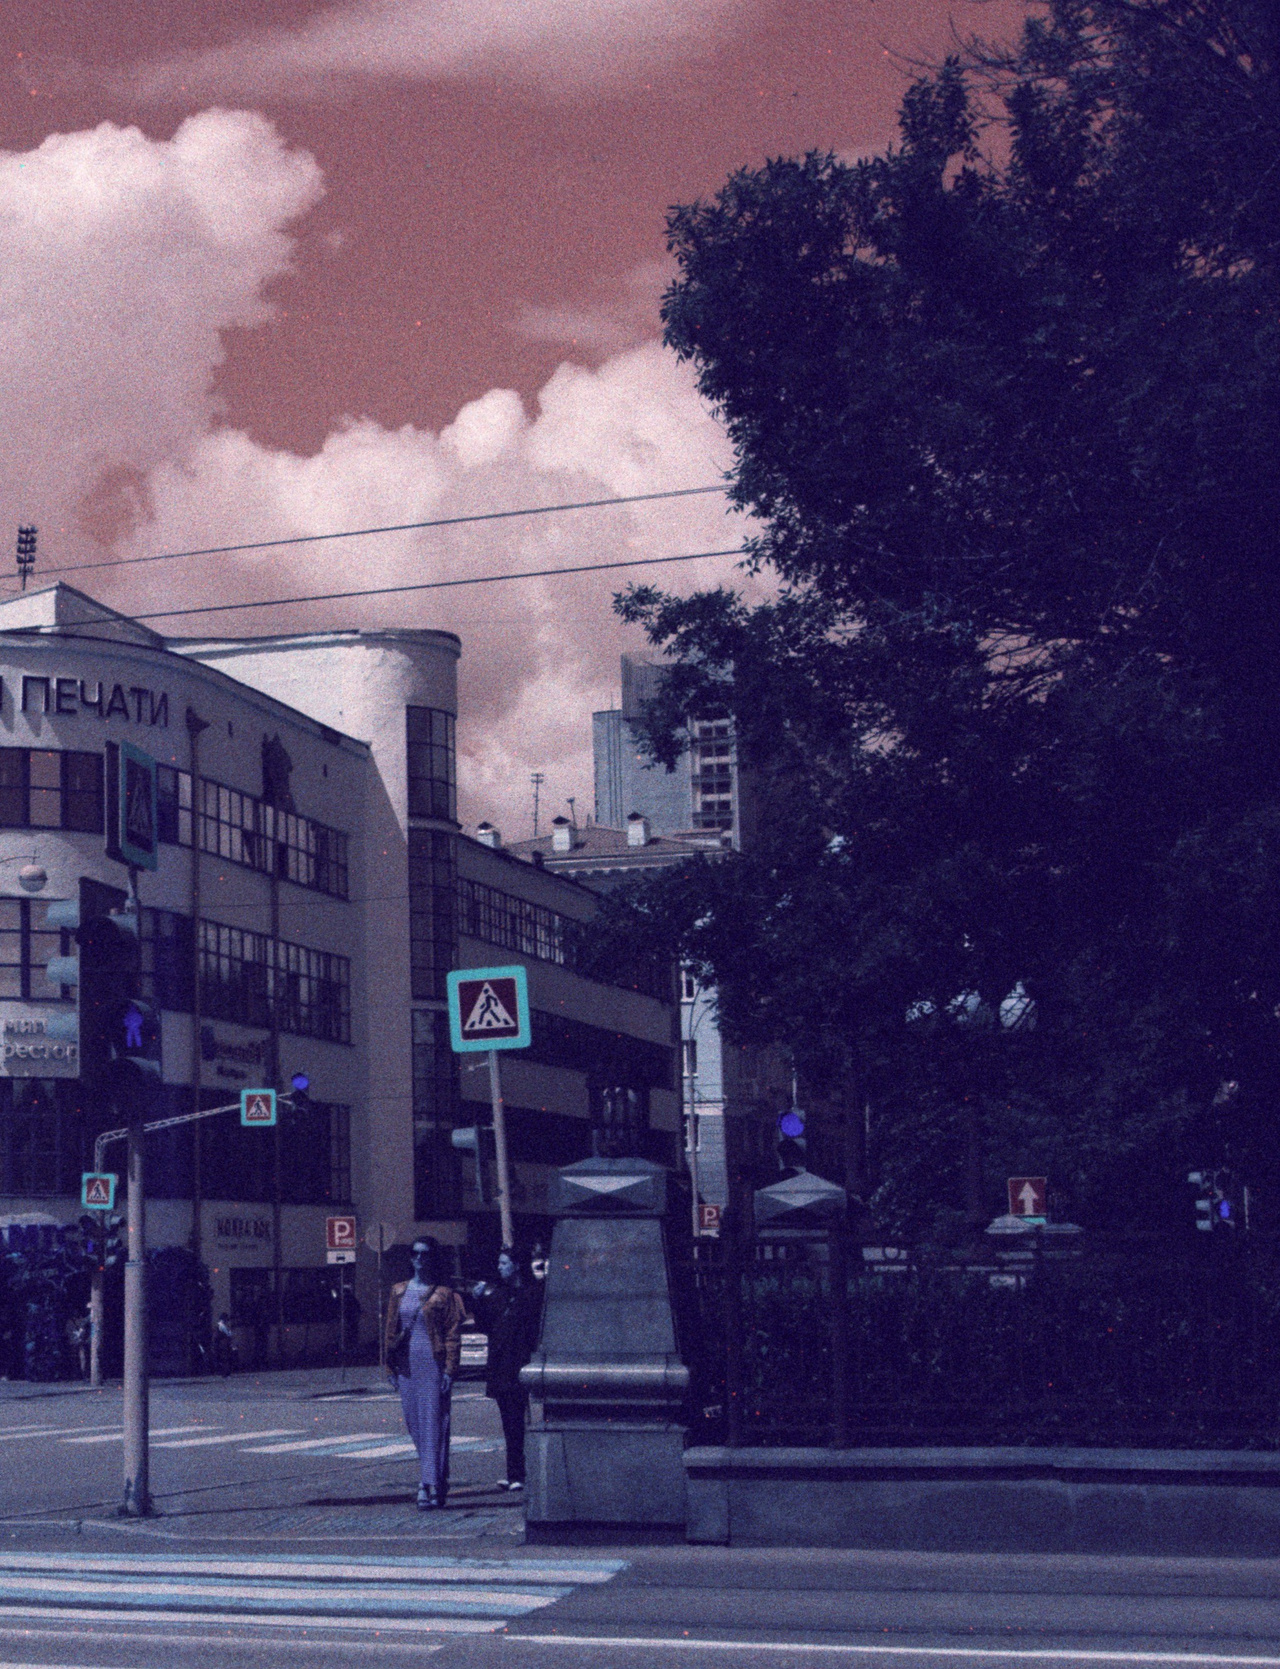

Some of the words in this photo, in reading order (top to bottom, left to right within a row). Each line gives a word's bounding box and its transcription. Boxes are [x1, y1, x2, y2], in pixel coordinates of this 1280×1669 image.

[21, 675, 169, 727] ПЕЧАТИ
[3, 1043, 79, 1063] рестор
[704, 1207, 717, 1226] P
[334, 1221, 350, 1246] P
